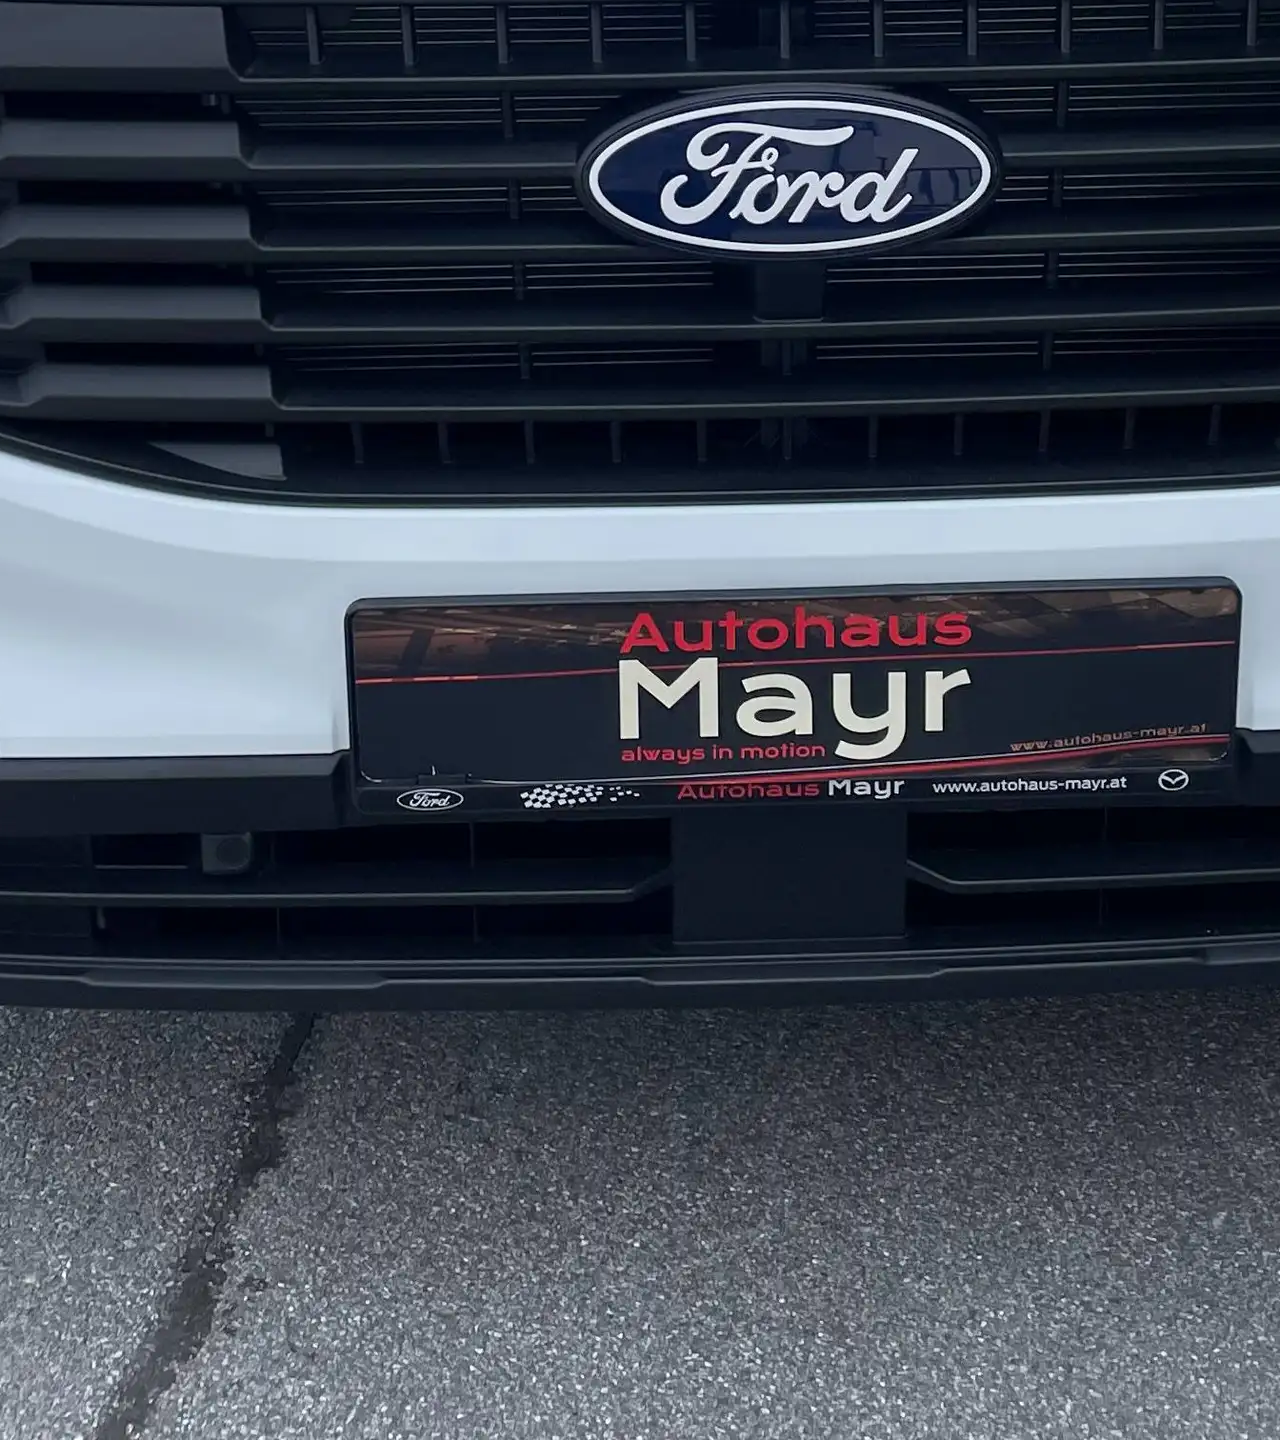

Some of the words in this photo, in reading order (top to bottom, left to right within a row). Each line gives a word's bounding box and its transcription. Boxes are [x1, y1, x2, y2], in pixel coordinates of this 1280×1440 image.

[660, 122, 919, 225] Ford
[620, 606, 973, 653] Autohaus
[618, 657, 972, 760] Mayr
[1010, 722, 1208, 752] www.autohaus-mayr.at
[621, 745, 706, 764] always
[711, 744, 734, 760] in
[739, 742, 826, 760] motion
[677, 782, 819, 801] Autohaus
[828, 779, 905, 799] Mayr
[932, 776, 1128, 794] www.autohaus-mayr.at
[409, 791, 451, 808] Ford
